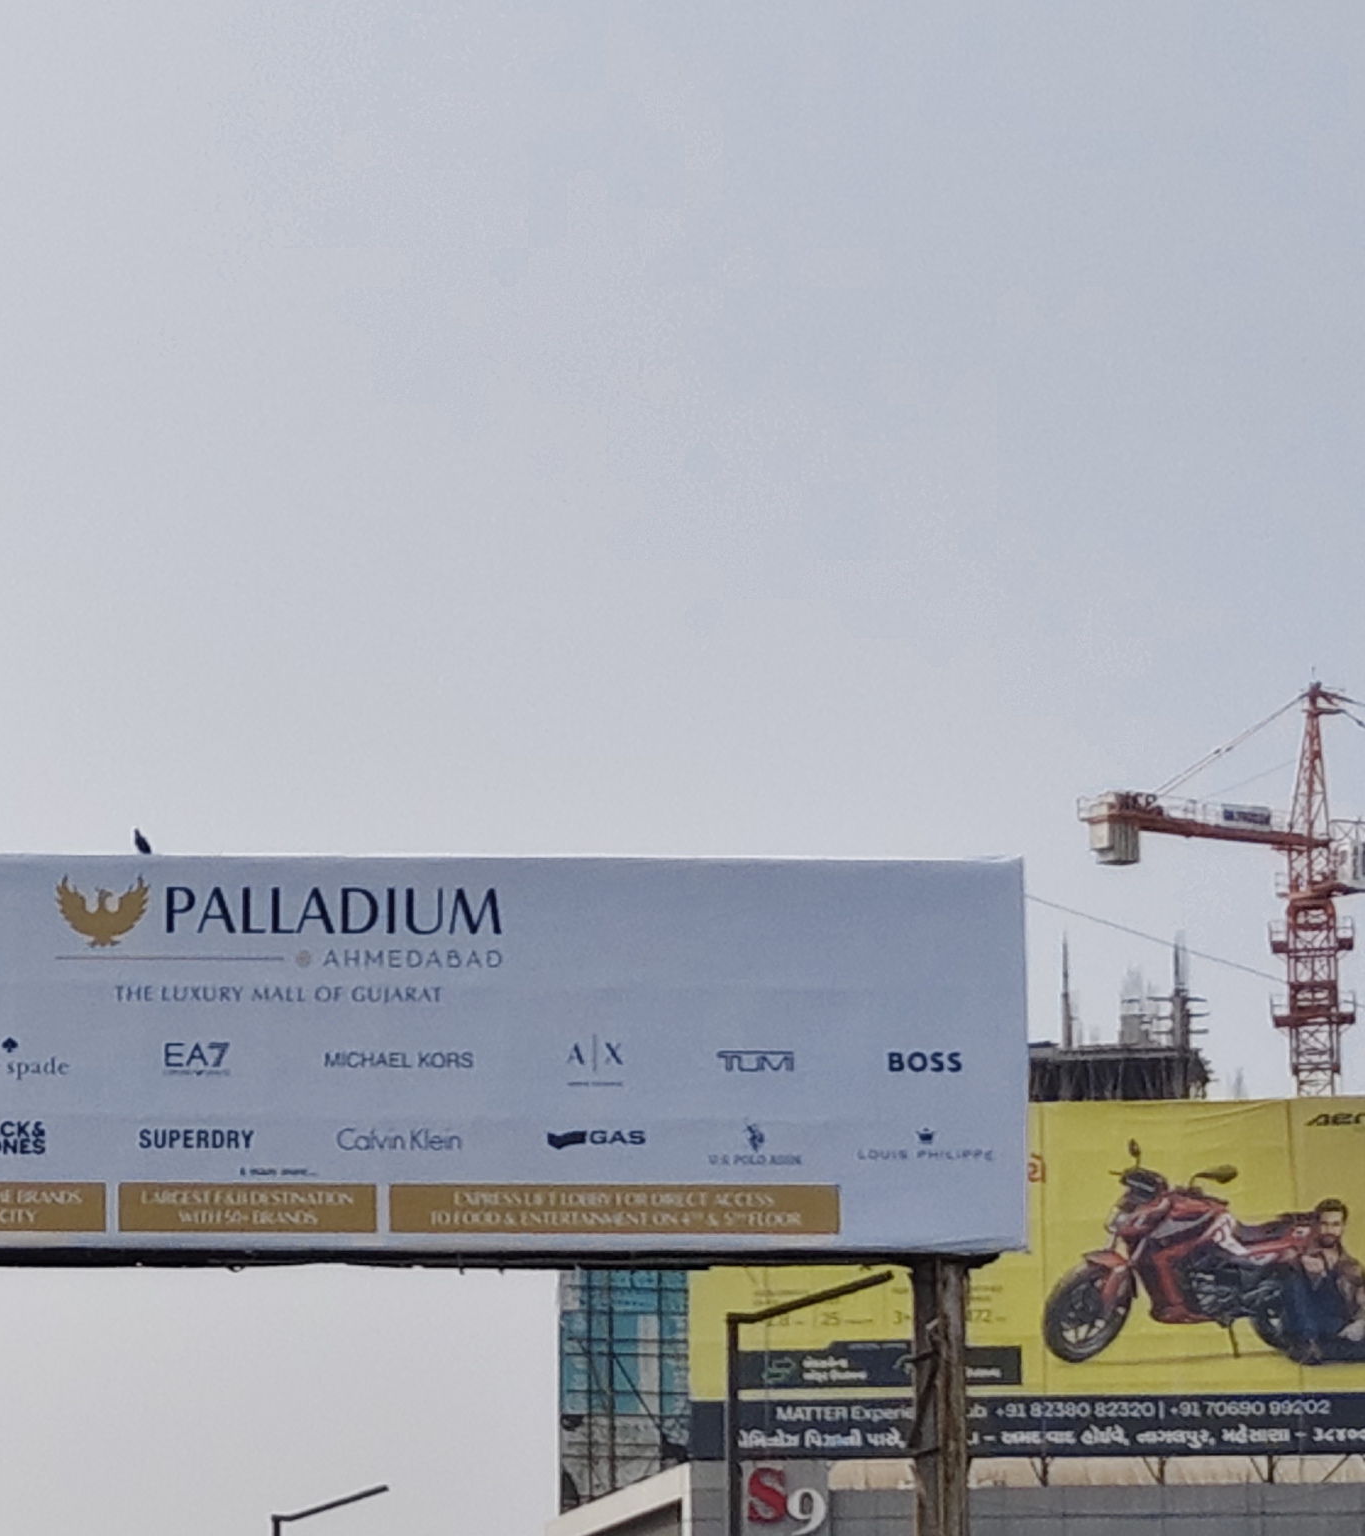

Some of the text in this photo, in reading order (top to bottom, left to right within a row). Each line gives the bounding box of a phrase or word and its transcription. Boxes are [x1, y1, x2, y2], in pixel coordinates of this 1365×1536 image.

[164, 886, 504, 936] PALLADIUM
[322, 948, 504, 969] AHMEDABAD
[115, 985, 442, 1004] THE LUXURY MALL OF GUJARAT
[164, 1041, 230, 1068] EA7
[323, 1051, 474, 1069] MICHAEL KORS
[887, 1051, 963, 1073] BOSS
[7, 1055, 70, 1081] spade
[138, 1128, 255, 1149] SUPERDRY
[336, 1127, 463, 1151] Calvin Klein
[589, 1129, 647, 1146] GAS
[857, 1149, 994, 1162] LOUIS PHILIPPE
[16, 1189, 83, 1205] BRANDS
[252, 1210, 319, 1226] BRANDS
[776, 1405, 848, 1422] MATTER
[996, 1402, 1027, 1418] +91
